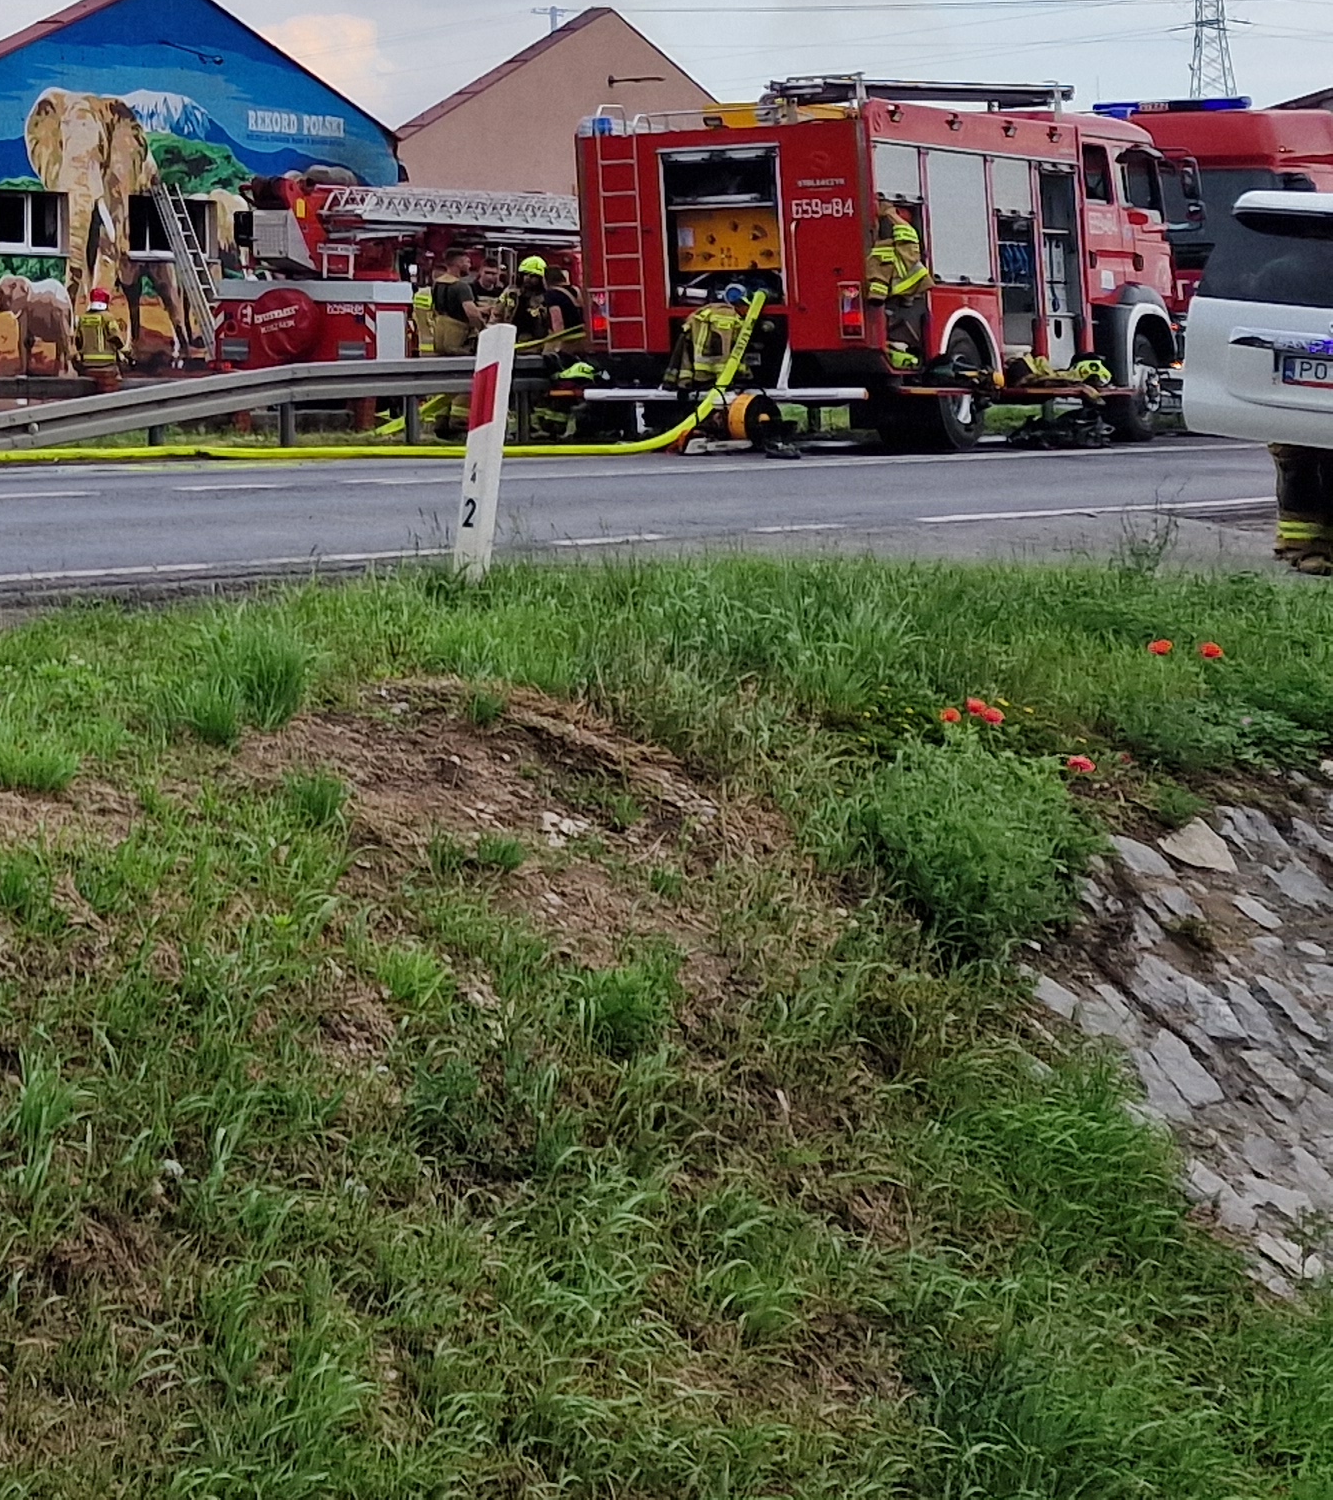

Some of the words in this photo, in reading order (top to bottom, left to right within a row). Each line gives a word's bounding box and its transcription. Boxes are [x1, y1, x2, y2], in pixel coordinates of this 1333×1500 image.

[247, 109, 298, 134] REKORD
[302, 114, 345, 138] POLSKI
[462, 498, 477, 528] 2
